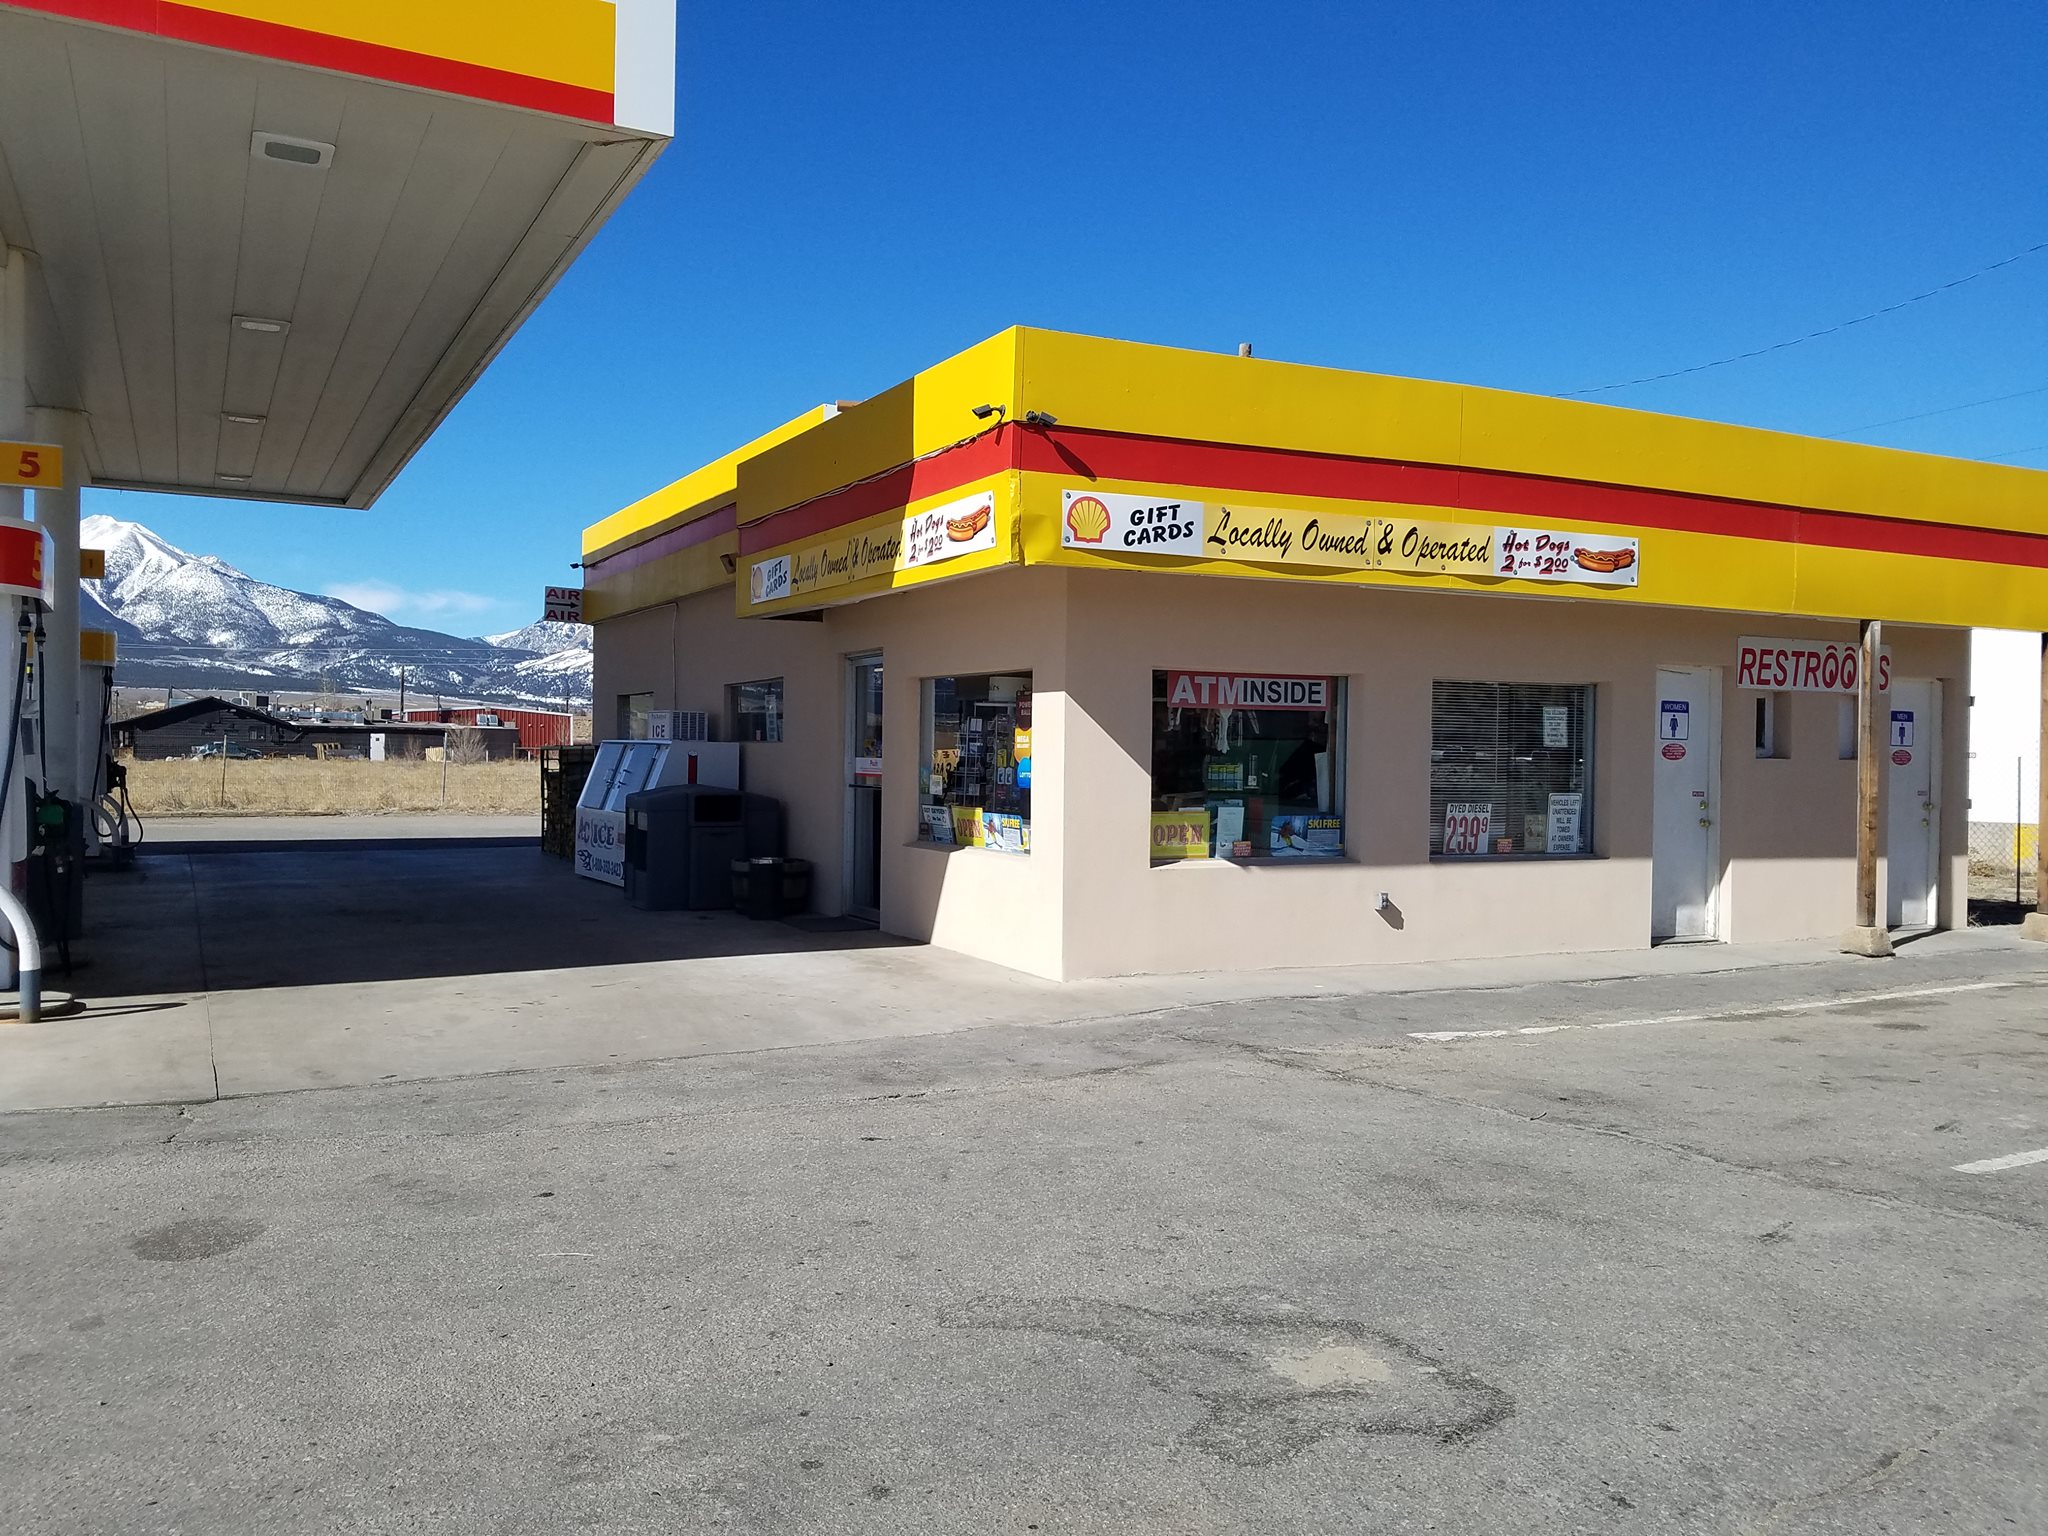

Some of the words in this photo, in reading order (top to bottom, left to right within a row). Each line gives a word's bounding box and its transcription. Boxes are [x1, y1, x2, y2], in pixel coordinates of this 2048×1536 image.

[18, 451, 41, 478] 5
[1130, 503, 1181, 526] GIFT
[910, 518, 923, 542] Hot
[925, 513, 944, 534] Dogs
[1123, 520, 1195, 547] CARDS
[1207, 511, 1293, 559] Locally
[1302, 518, 1369, 556] Owned
[1377, 523, 1394, 556] &
[1402, 526, 1491, 567] Operated
[1502, 532, 1529, 553] Hot
[1535, 534, 1569, 553] Dogs
[791, 555, 818, 587] Locally
[820, 540, 850, 578] Owned
[861, 530, 903, 572] Operated
[1500, 557, 1515, 573] 2
[1518, 558, 1531, 569] for
[766, 560, 783, 582] GIFT
[546, 588, 581, 601] AIR
[765, 571, 788, 598] CARDS
[545, 609, 580, 622] AIR
[1738, 644, 1890, 691] RESTROOS
[1171, 675, 1241, 705] ATM
[1243, 680, 1322, 705] INSIDE
[1664, 703, 1687, 711] WOMEN
[1896, 713, 1908, 721] MEN
[652, 724, 665, 738] ICE
[1449, 804, 1467, 813] DYED
[1468, 804, 1490, 814] DIESEL
[1153, 824, 1204, 847] OPEN
